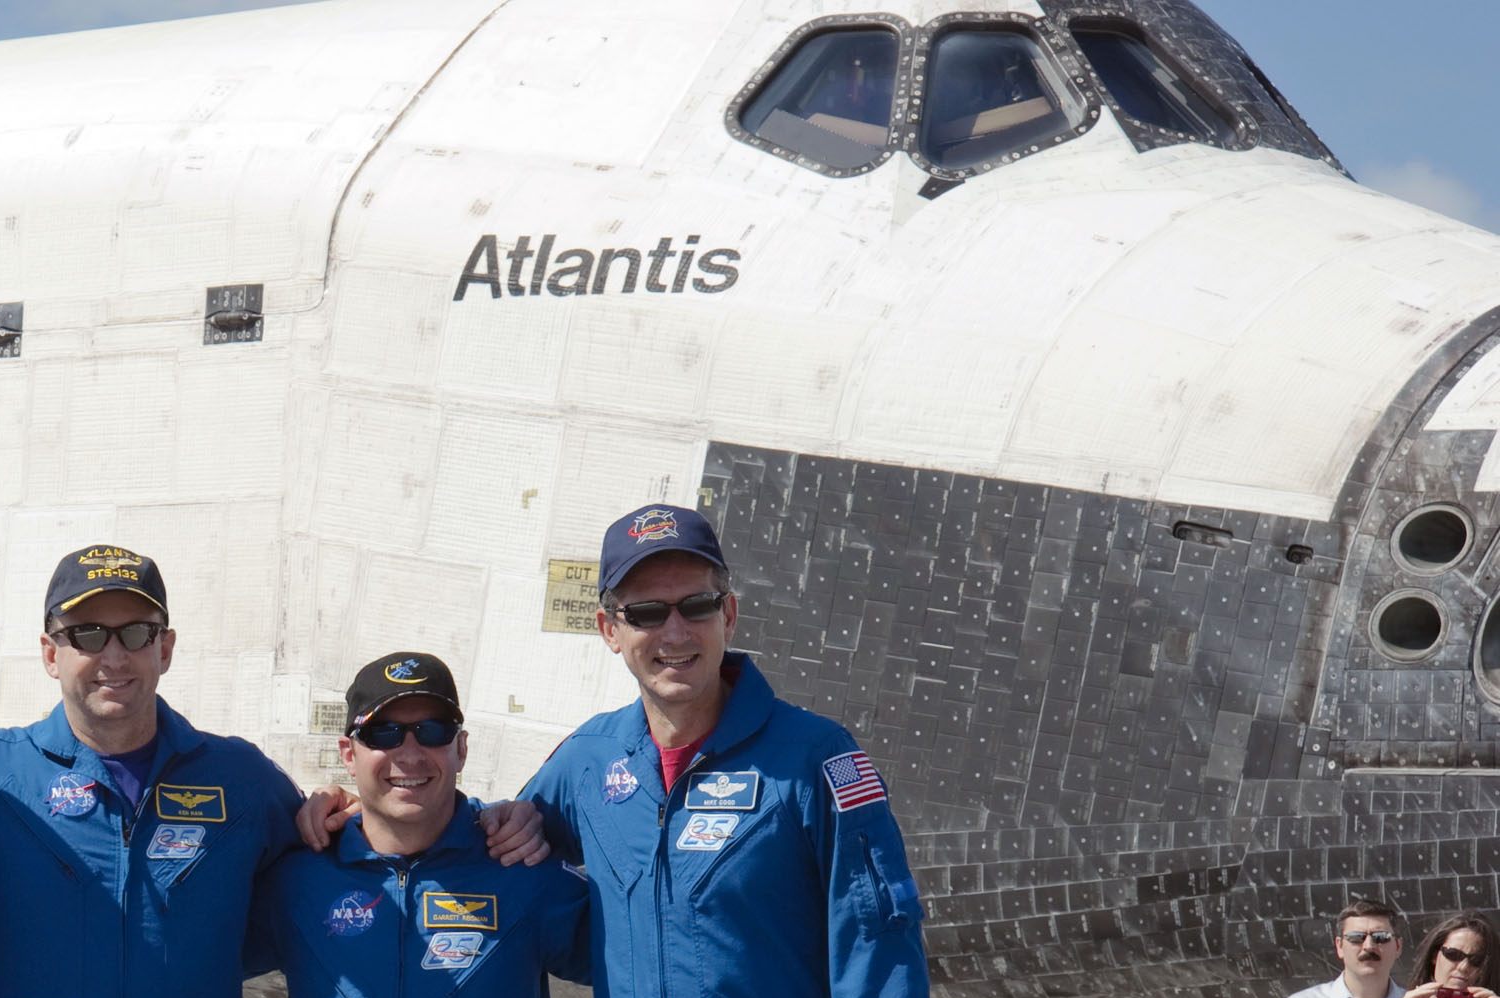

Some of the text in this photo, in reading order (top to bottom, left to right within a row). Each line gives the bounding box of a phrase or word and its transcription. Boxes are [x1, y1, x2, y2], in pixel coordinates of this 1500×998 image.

[452, 234, 741, 301] Atlantis
[78, 548, 143, 564] ATLANTIS
[87, 568, 139, 581] STS-132
[565, 566, 592, 580] CUT
[580, 584, 598, 597] FO
[552, 599, 599, 613] EMERG
[566, 616, 599, 630] RESC
[606, 773, 638, 787] NASA
[52, 787, 94, 801] NASA
[683, 818, 729, 846] 25
[153, 828, 197, 853] 25
[331, 907, 374, 920] NASA
[427, 937, 474, 964] 25
